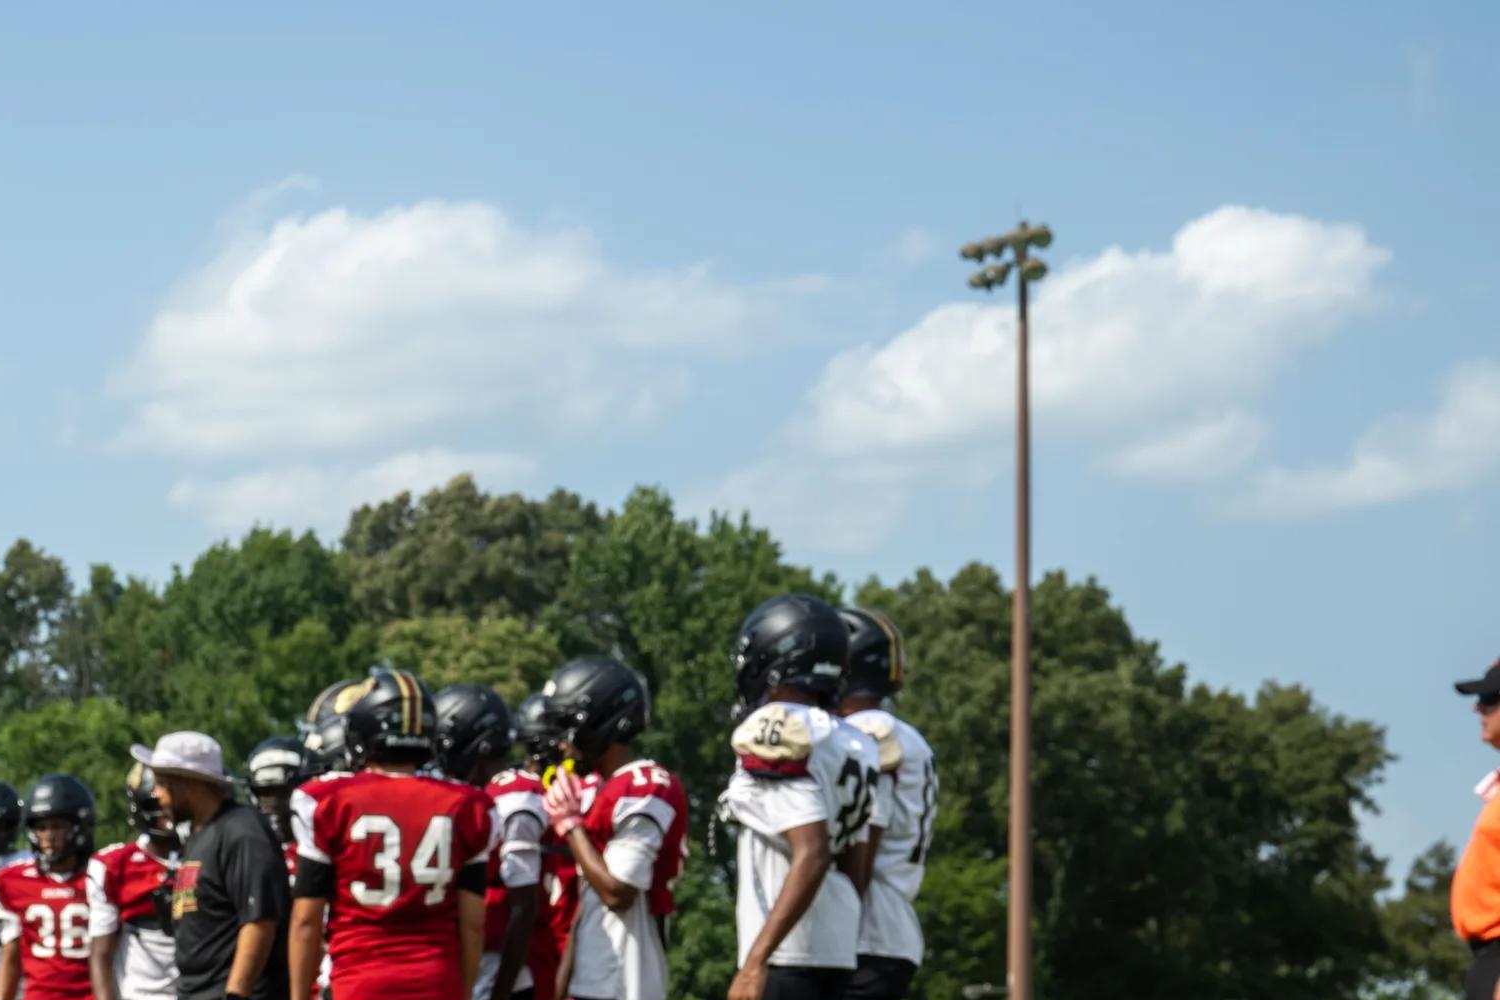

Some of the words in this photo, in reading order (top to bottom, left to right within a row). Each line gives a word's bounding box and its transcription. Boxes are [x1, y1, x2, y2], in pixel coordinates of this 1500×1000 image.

[753, 717, 786, 747] 36
[350, 814, 454, 907] 34
[24, 903, 92, 959] 36
